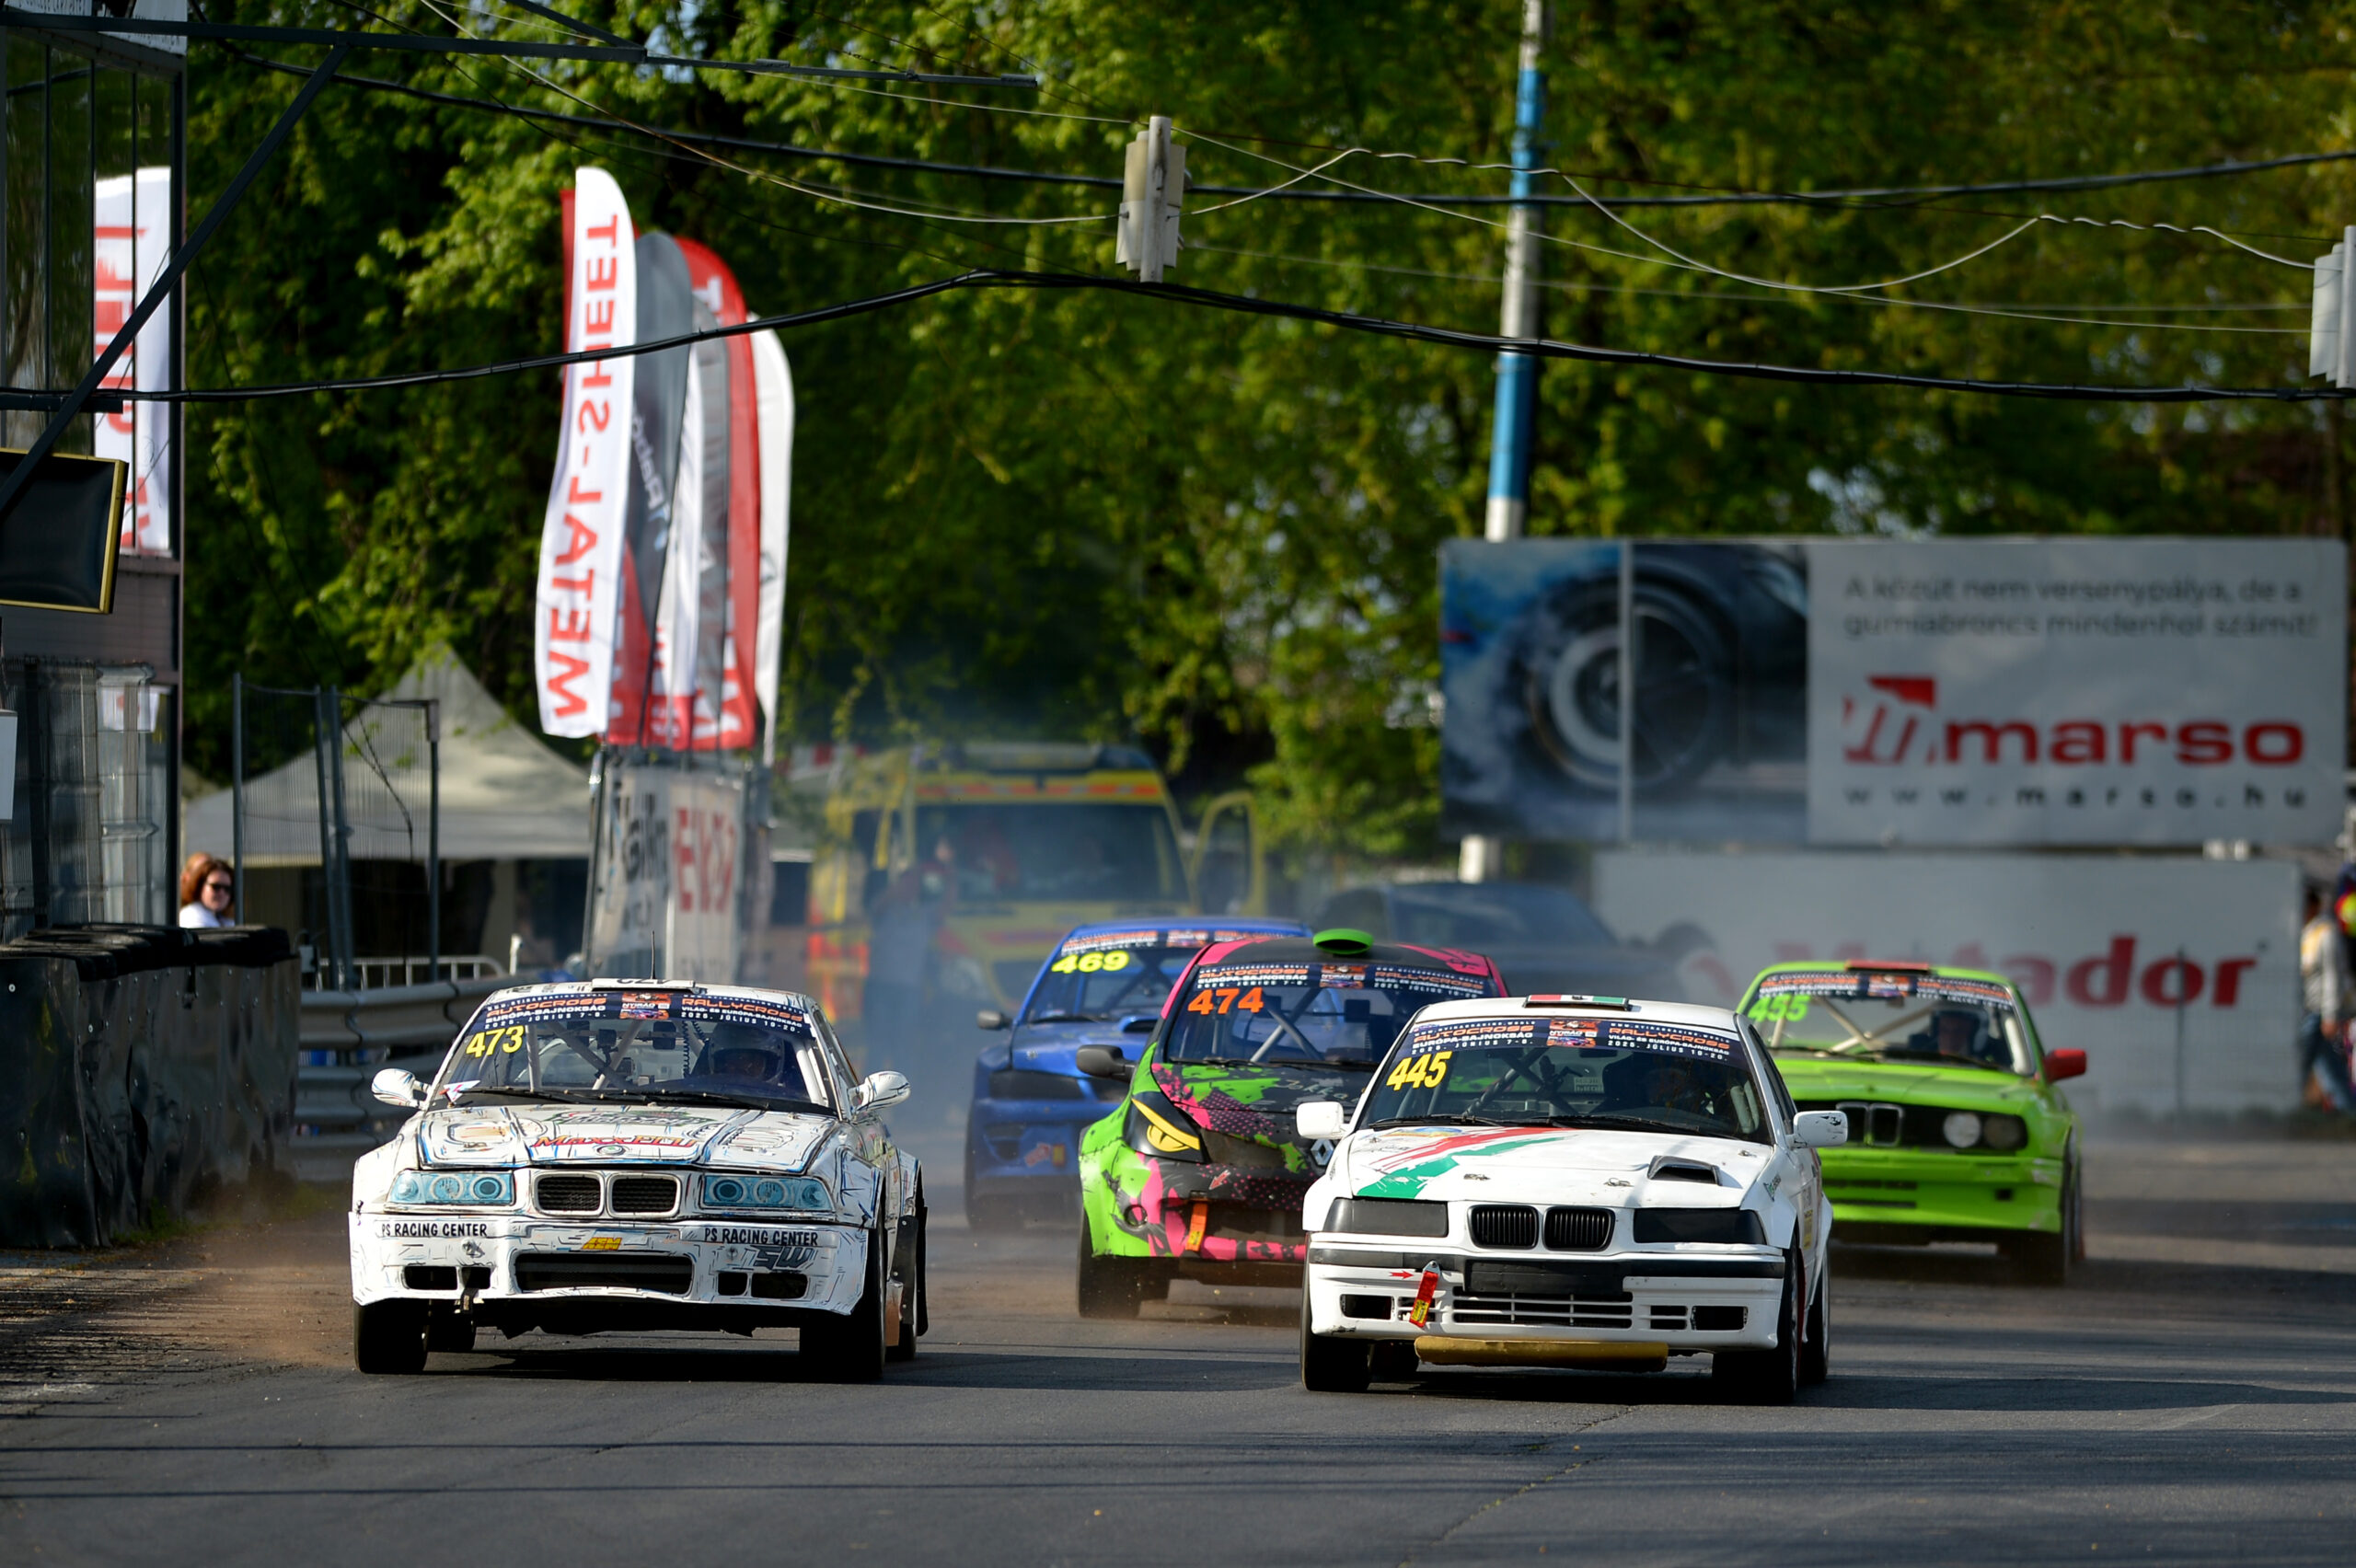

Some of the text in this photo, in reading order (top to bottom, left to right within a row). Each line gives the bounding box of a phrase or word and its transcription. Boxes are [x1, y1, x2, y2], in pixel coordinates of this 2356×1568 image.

[1961, 581, 2030, 599] nem
[2238, 576, 2278, 600] de
[1943, 719, 2305, 767] marso
[1845, 782, 2307, 809] www.marso.hu
[1051, 951, 1129, 974] 469
[486, 997, 606, 1018] AUTOCROSS
[682, 997, 803, 1021] RALLYCROSS
[1187, 986, 1265, 1015] 474
[1749, 995, 1810, 1022] 455
[485, 1005, 606, 1023] EURÓPA-BAJNOKSÁG
[466, 1025, 525, 1057] 473
[1412, 1032, 1533, 1049] EURÓPA-BAJNOKSÁG
[1414, 1025, 1534, 1043] AUTOCROSS
[1609, 1027, 1730, 1049] RALLYCROSS
[1386, 1051, 1452, 1091] 445
[381, 1222, 488, 1237] PS RACING CENTER
[704, 1228, 818, 1246] PS RACING CENTER
